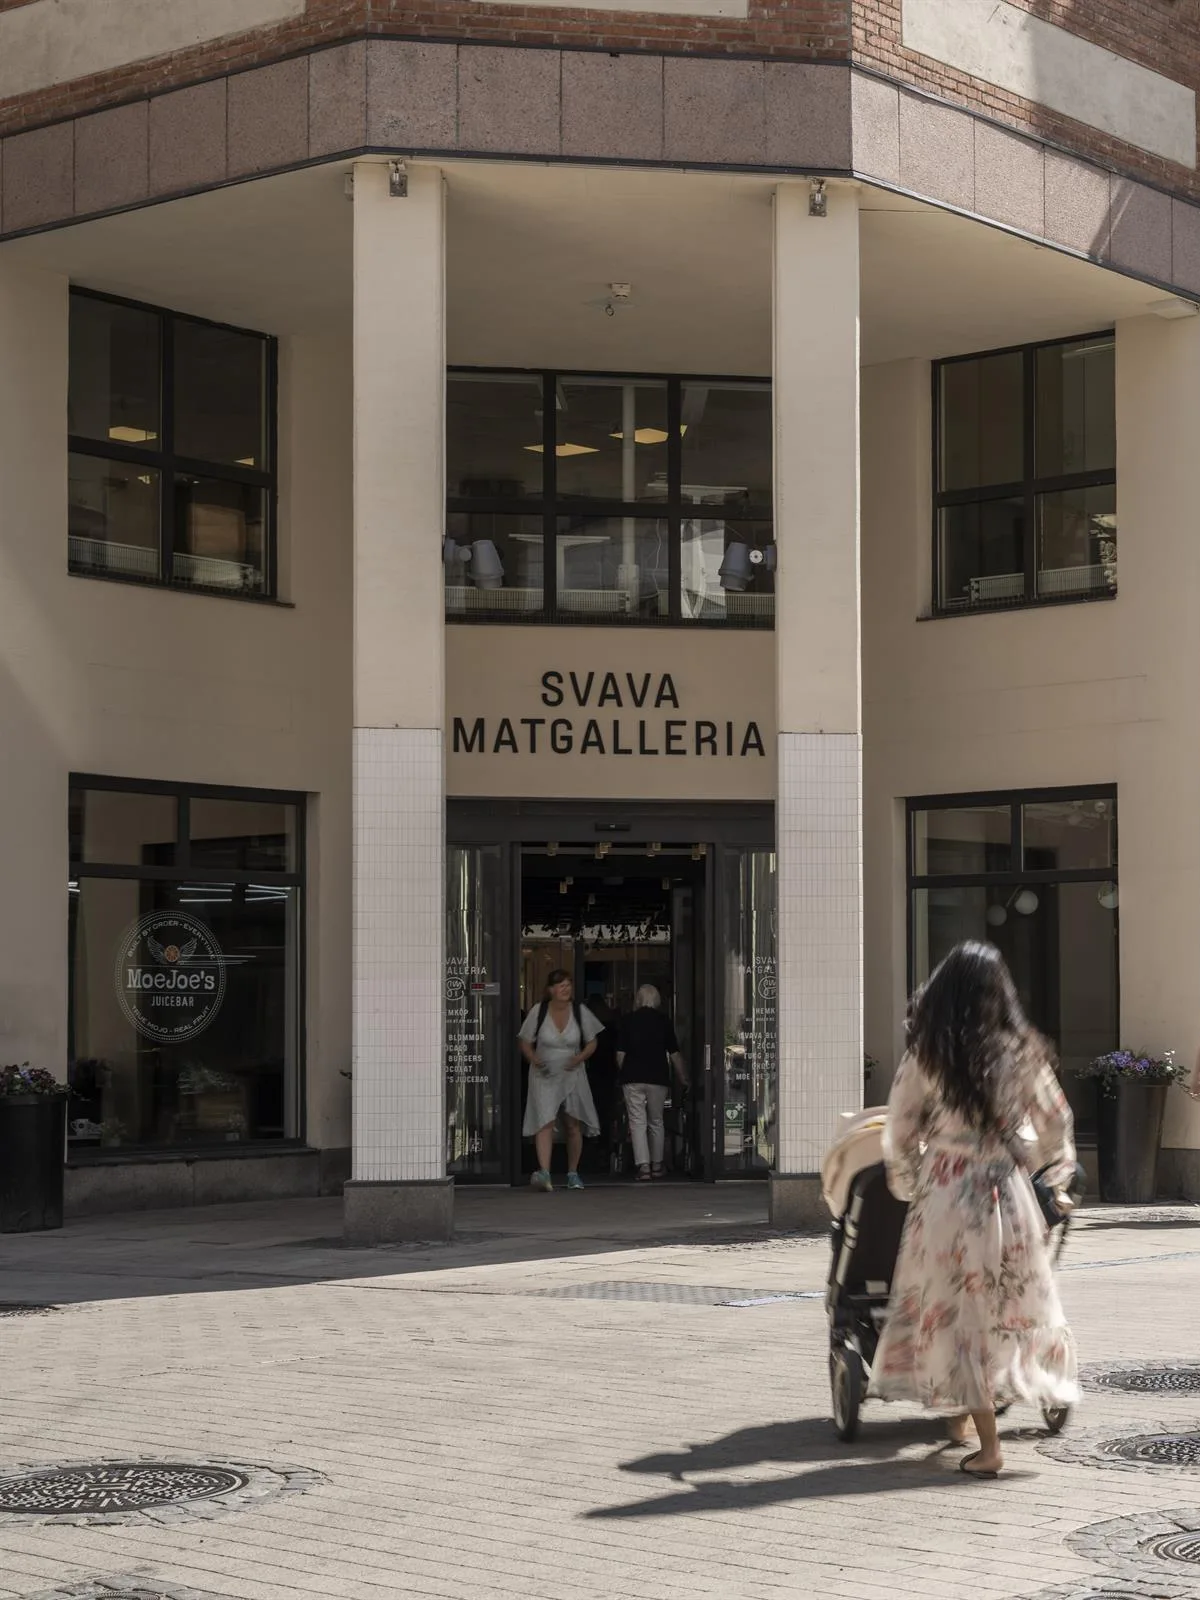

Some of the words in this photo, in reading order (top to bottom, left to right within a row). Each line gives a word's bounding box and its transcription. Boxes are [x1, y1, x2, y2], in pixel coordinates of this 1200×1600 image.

[541, 670, 680, 708] SVAVA
[452, 717, 766, 757] MATGALLERIA
[152, 920, 180, 930] ORDER
[446, 956, 469, 965] VAVA
[755, 956, 777, 965] SVA
[446, 966, 488, 975] ALLERIA
[126, 968, 216, 990] MoeJoe's
[151, 996, 194, 1007] JUICEBAR
[447, 1007, 469, 1016] MKÖP
[755, 1007, 776, 1015] HEMK
[132, 1004, 147, 1024] TRUE
[148, 1021, 169, 1034] MOJO
[173, 1024, 194, 1034] REAL
[192, 1005, 211, 1026] FRUIT
